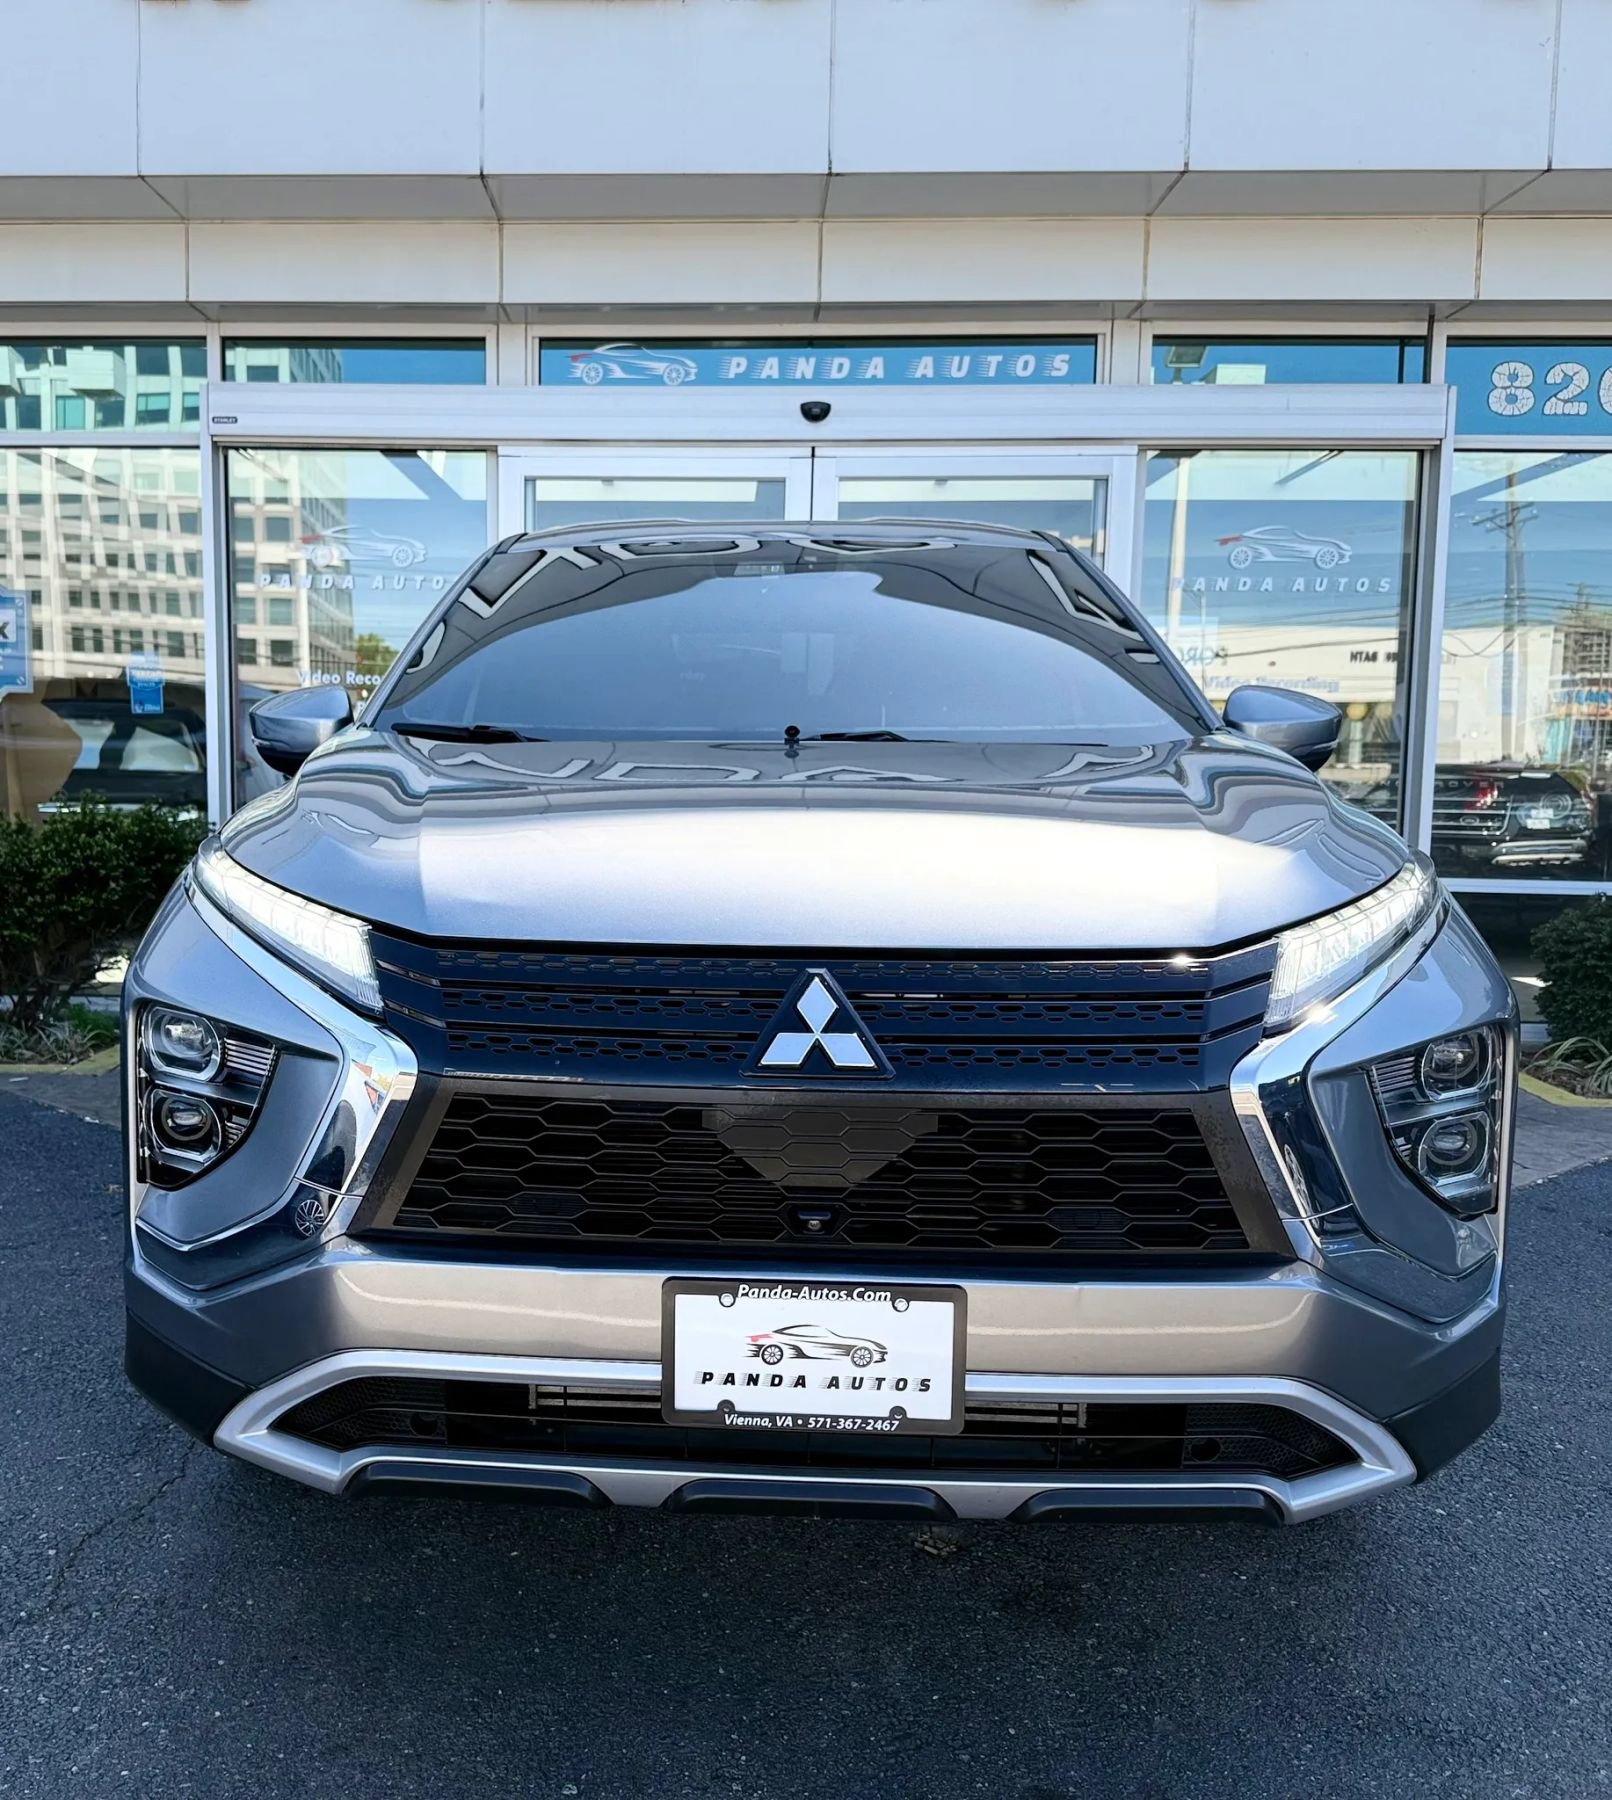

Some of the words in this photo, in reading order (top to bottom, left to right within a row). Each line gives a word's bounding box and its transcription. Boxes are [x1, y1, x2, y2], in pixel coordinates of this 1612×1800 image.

[719, 356, 885, 379] PANDA
[906, 354, 1070, 378] AUTOS
[258, 574, 355, 589] PANDA
[373, 575, 449, 590] AUTO
[1172, 576, 1273, 592] PANDA
[1292, 577, 1391, 592] AUTOS
[297, 671, 341, 685] Video
[737, 1284, 892, 1302] Panda-Autos.Com
[696, 1371, 807, 1389] PANDA
[817, 1375, 931, 1392] AUTOS
[724, 1413, 772, 1428] Vienna,
[776, 1415, 793, 1428] VA
[807, 1417, 900, 1431] 571-367-2467
